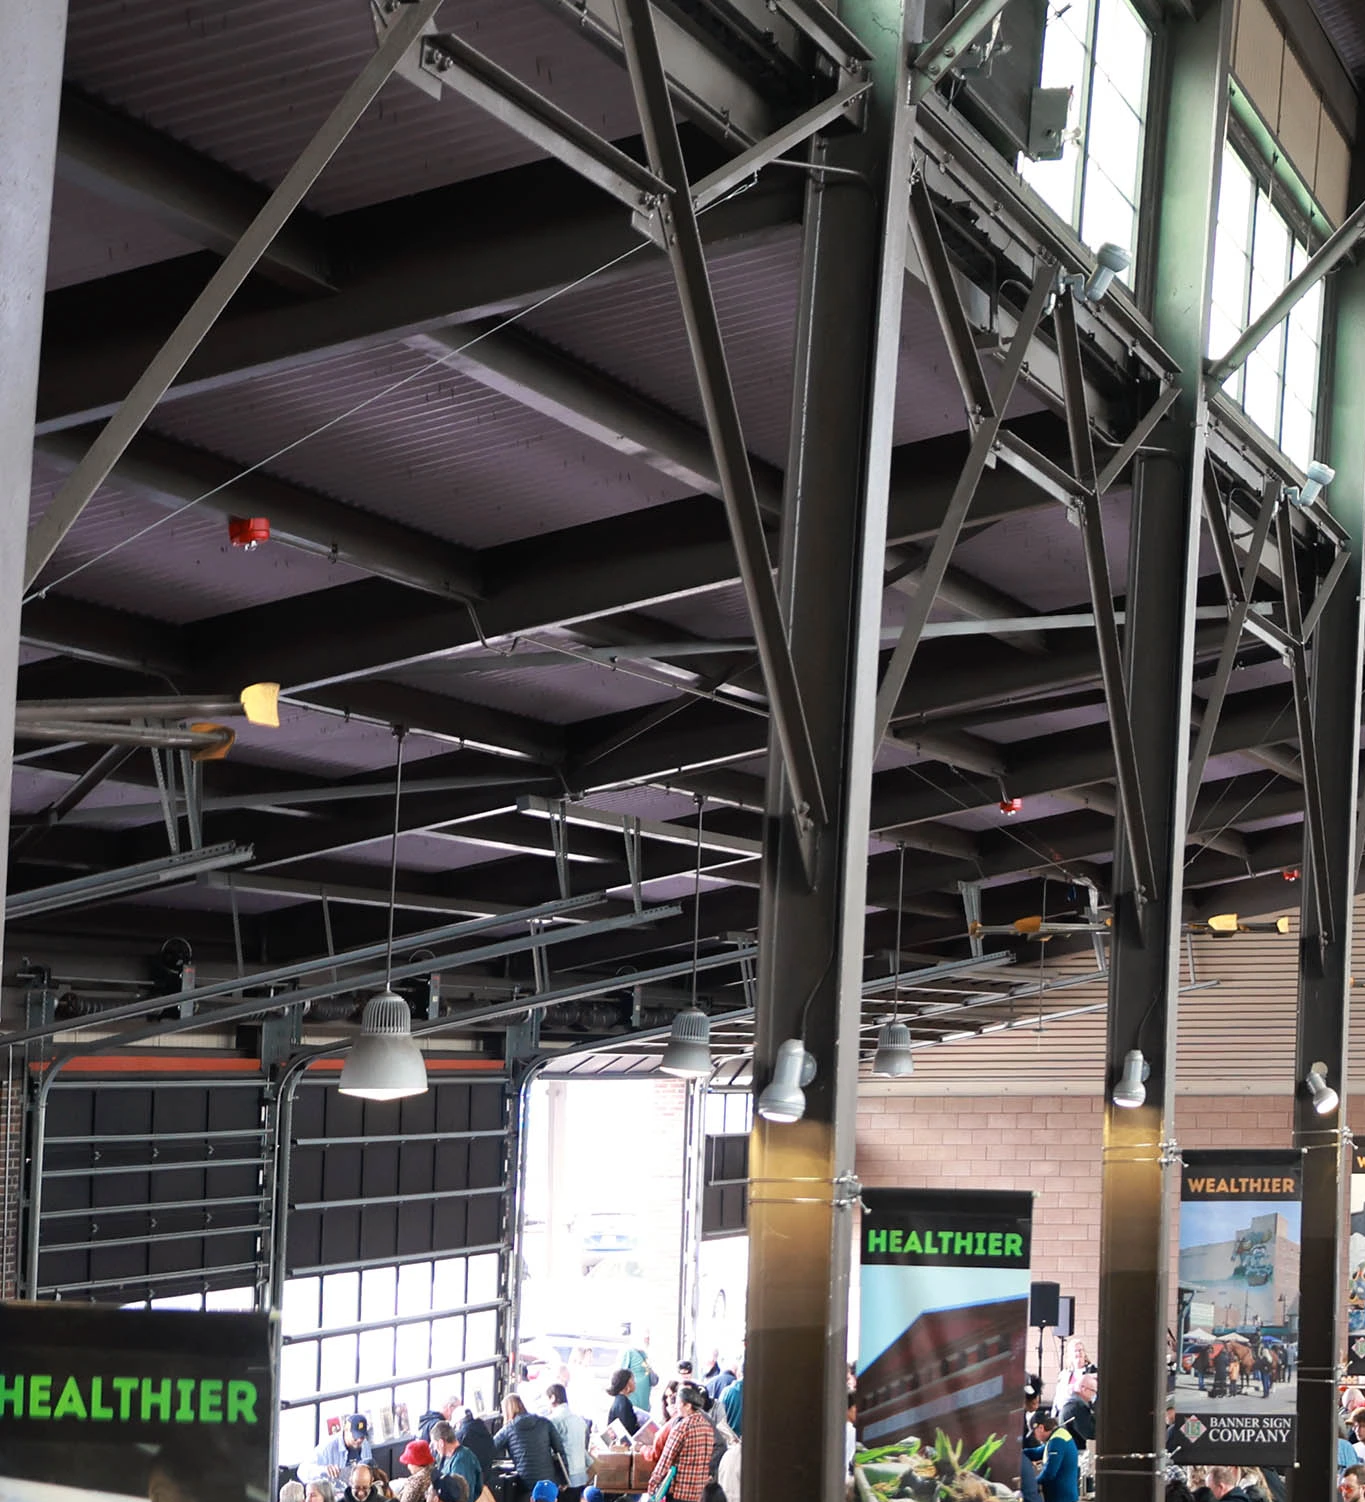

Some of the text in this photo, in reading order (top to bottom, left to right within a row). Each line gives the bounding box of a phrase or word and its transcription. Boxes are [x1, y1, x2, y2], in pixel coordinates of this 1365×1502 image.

[1187, 1177, 1295, 1194] WEALTHIER
[867, 1228, 1024, 1258] HEALTHIER
[0, 1374, 259, 1424] HEALTHIER
[1210, 1416, 1292, 1429] BANNER SIGN
[1208, 1428, 1291, 1443] COMPANY
